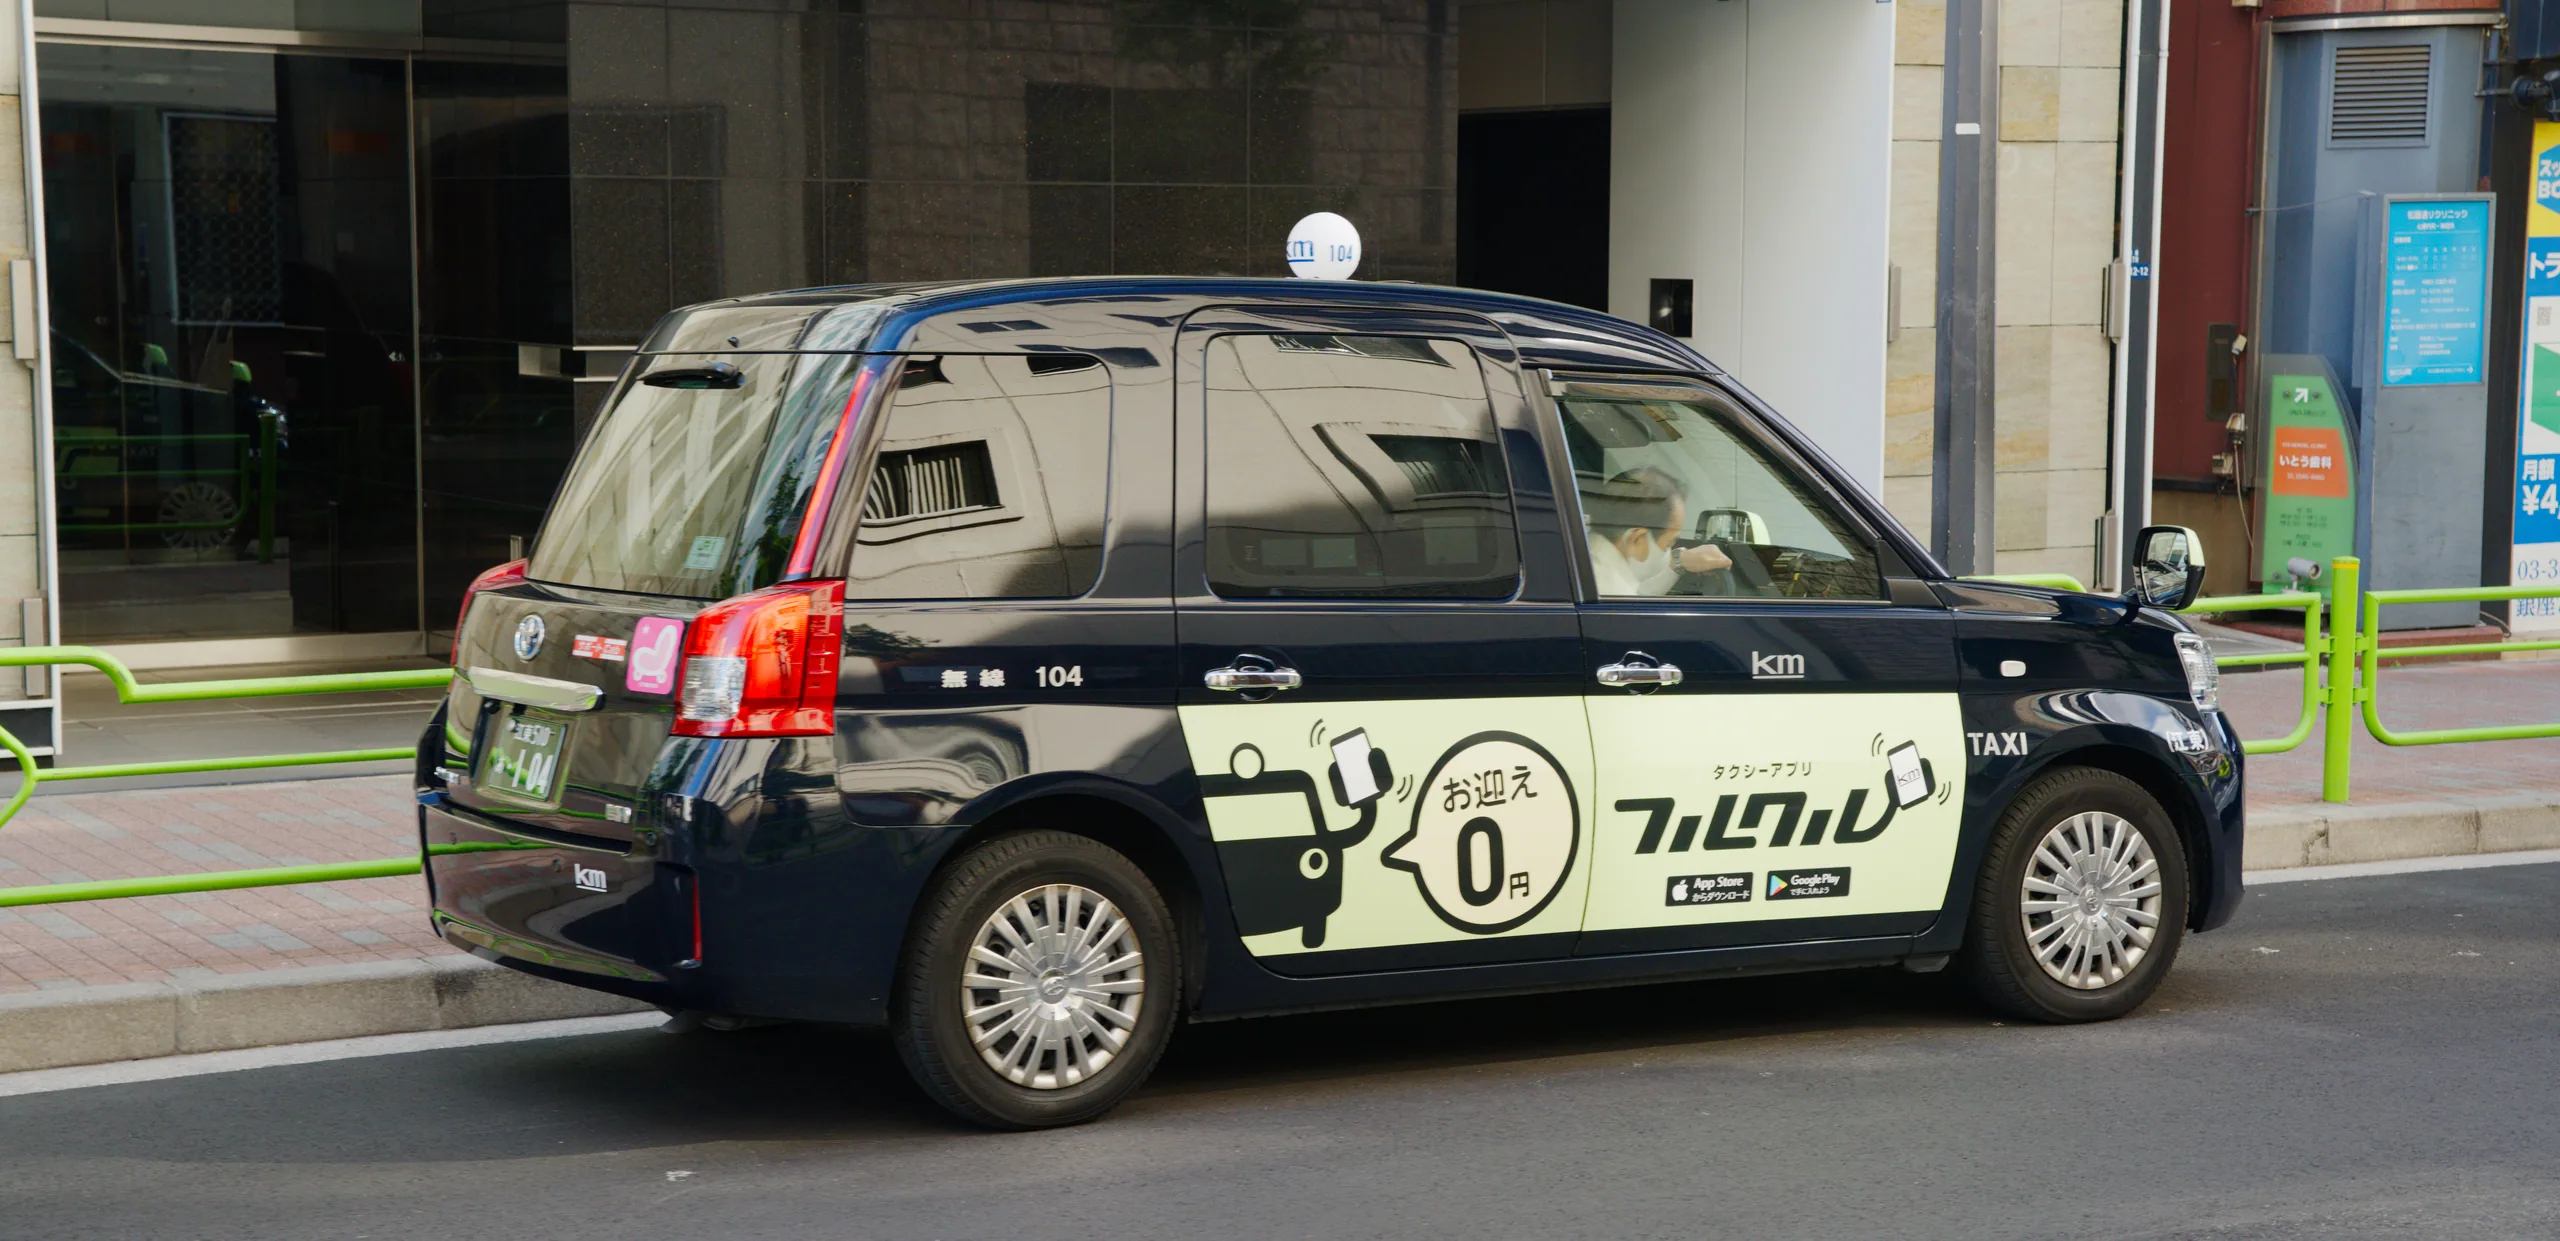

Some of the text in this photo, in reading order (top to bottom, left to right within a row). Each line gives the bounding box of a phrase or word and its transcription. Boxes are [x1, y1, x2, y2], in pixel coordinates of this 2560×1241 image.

[1329, 245, 1352, 262] 104
[2280, 454, 2332, 469] いとう歯科
[2522, 458, 2555, 481] 月額
[2516, 597, 2555, 616] 銀座
[1752, 651, 1804, 679] km
[941, 665, 1083, 688] 無線 104
[1967, 732, 2028, 756] TAXI
[1714, 761, 1811, 780] タクシーアプリ
[1897, 768, 1920, 787] km
[1443, 766, 1537, 812] お迎え
[1614, 788, 1900, 854] フルクル
[574, 863, 607, 892] km
[1693, 876, 1744, 891] App Store
[1790, 873, 1840, 887] Google Play
[1692, 890, 1750, 902] からダウンロード
[1790, 887, 1830, 896] で手に入れよう
